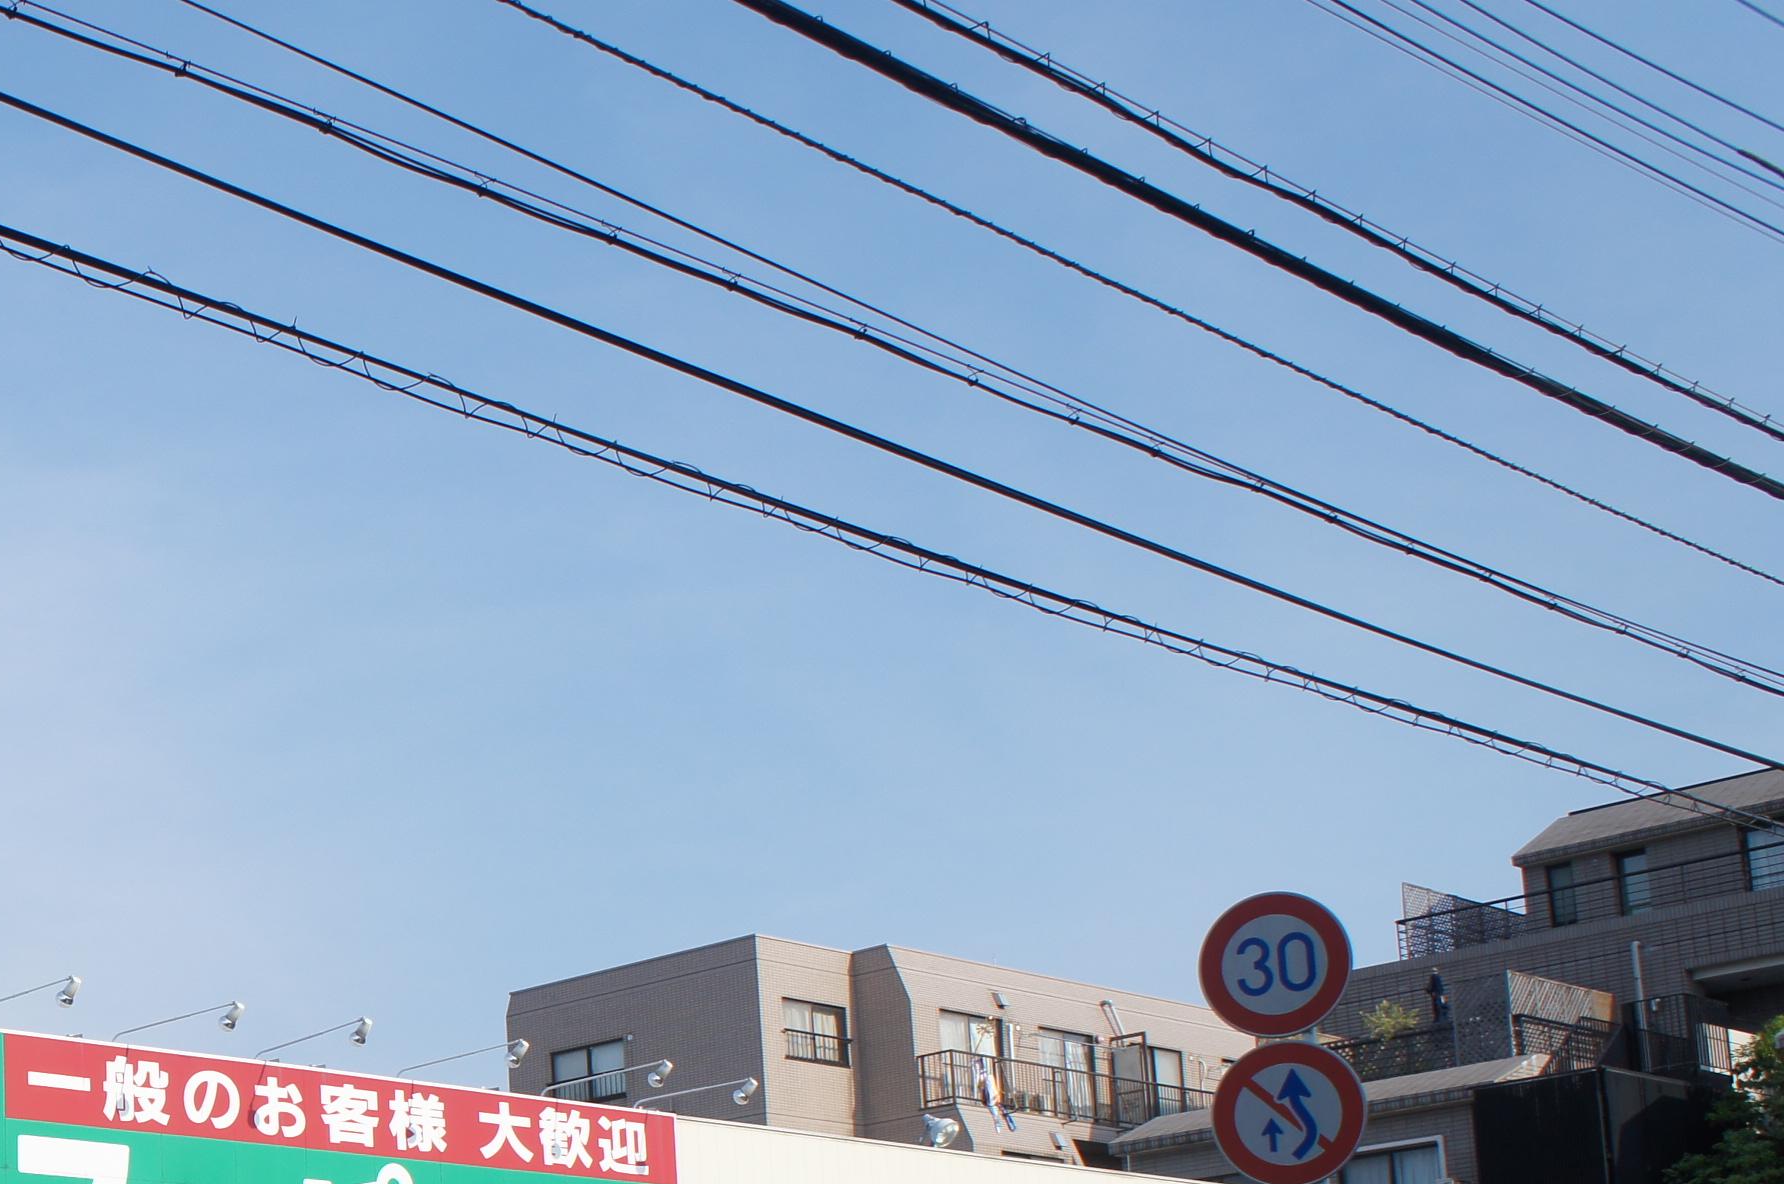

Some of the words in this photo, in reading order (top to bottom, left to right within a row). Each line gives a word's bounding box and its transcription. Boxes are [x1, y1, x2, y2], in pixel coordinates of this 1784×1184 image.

[1235, 931, 1317, 997] 30
[27, 1056, 449, 1154] 一般のお客様
[479, 1100, 650, 1177] 大歓迎
